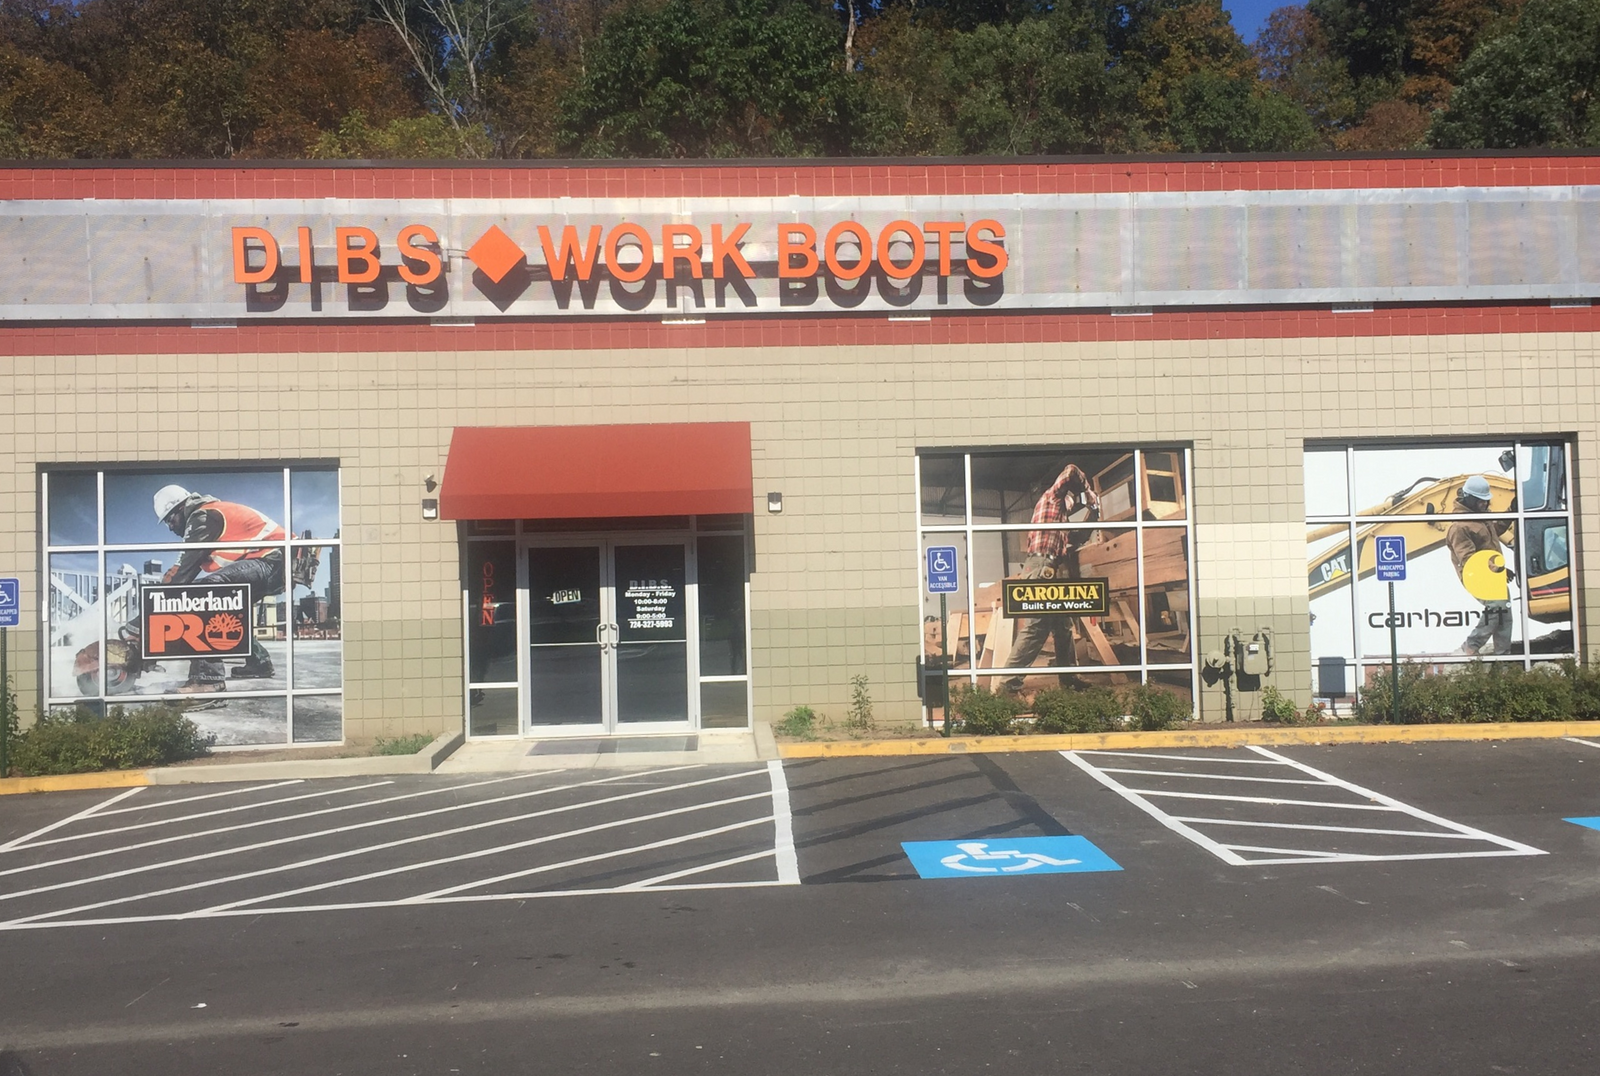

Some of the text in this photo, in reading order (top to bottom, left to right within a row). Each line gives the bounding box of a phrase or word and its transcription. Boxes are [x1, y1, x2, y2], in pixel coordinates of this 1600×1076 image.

[232, 219, 1008, 285] DIBS WORK BOOTS
[149, 589, 244, 613] Timberland
[482, 561, 495, 626] OPEN
[554, 590, 580, 604] OPEN
[1012, 585, 1099, 601] CAROLINA
[1022, 602, 1044, 610] Built
[1046, 602, 1062, 610] For
[1368, 607, 1509, 629] carhartt
